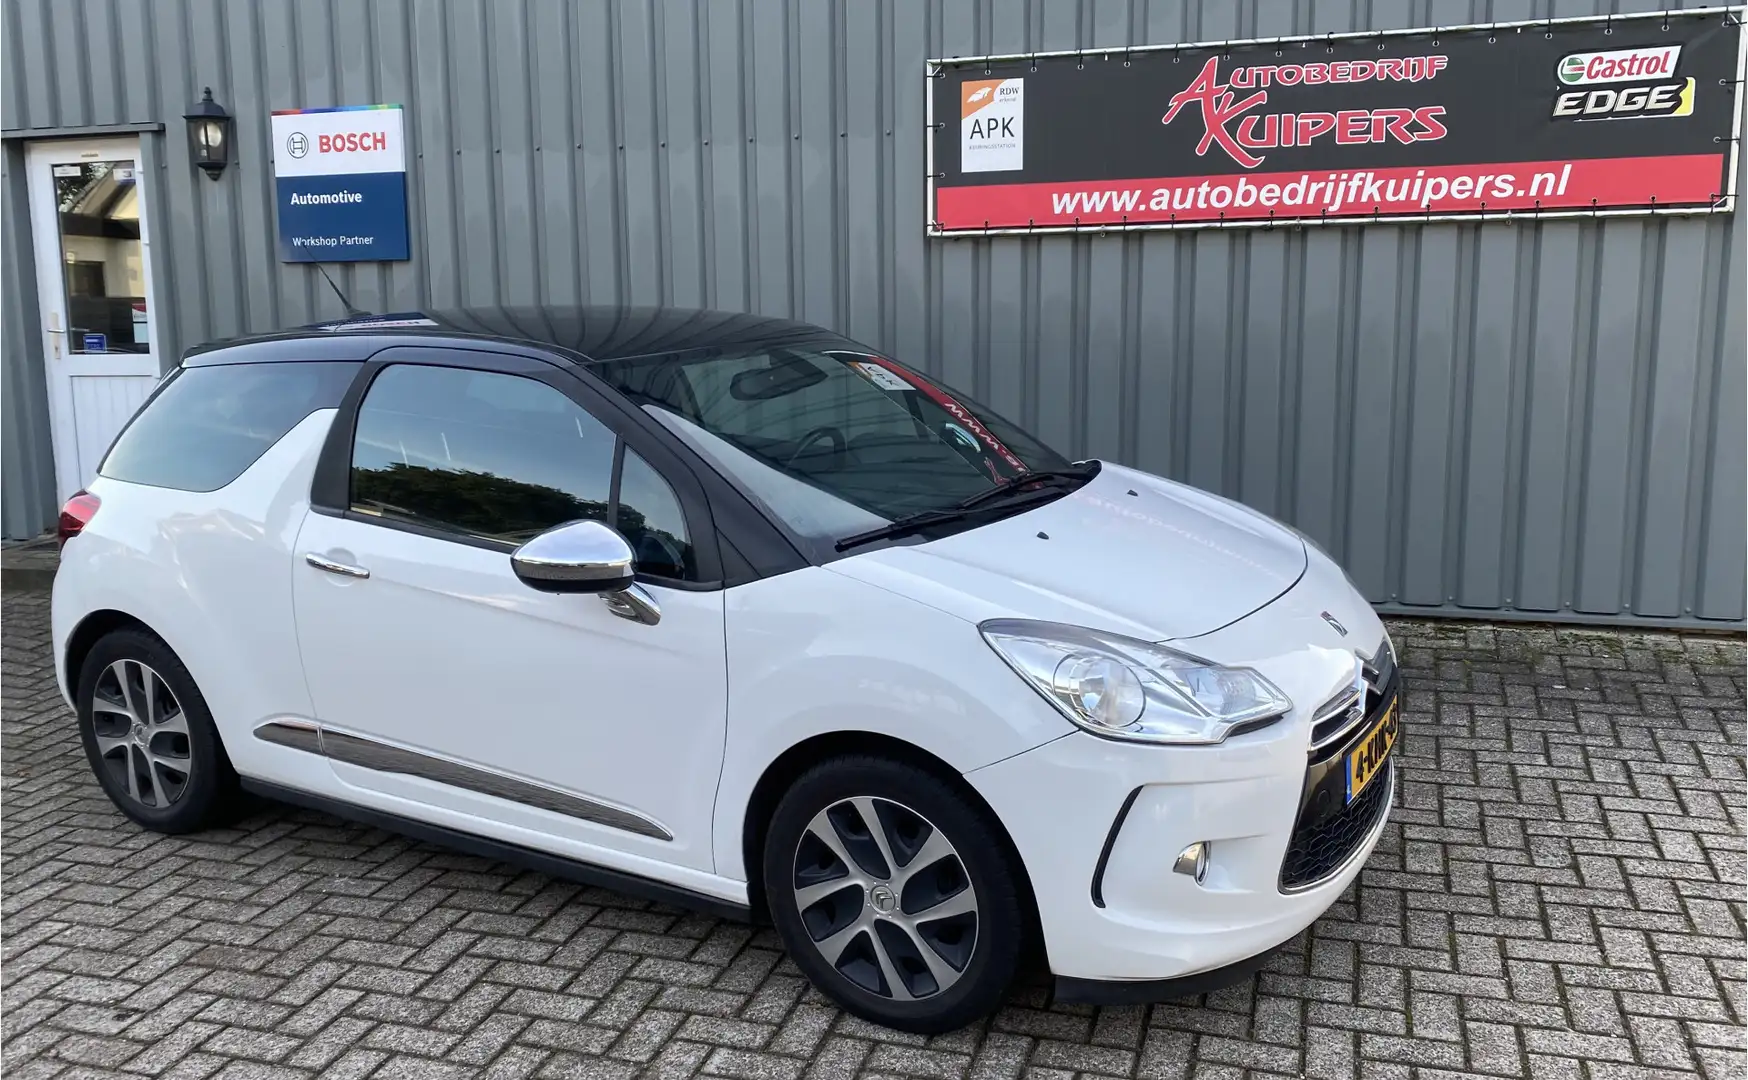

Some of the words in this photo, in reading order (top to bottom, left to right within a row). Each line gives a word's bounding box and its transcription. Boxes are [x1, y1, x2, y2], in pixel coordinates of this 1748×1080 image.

[1586, 51, 1671, 80] Castrol
[999, 87, 1020, 96] RDW
[1552, 84, 1684, 117] EDGE
[969, 116, 1015, 140] APK
[1195, 90, 1448, 168] KUIPERS
[318, 131, 386, 153] BOSCH
[290, 190, 362, 205] Automotive
[1051, 163, 1573, 212] www.autobedrijfkuipers.nl
[292, 236, 337, 247] Workshop
[340, 235, 374, 246] Partner
